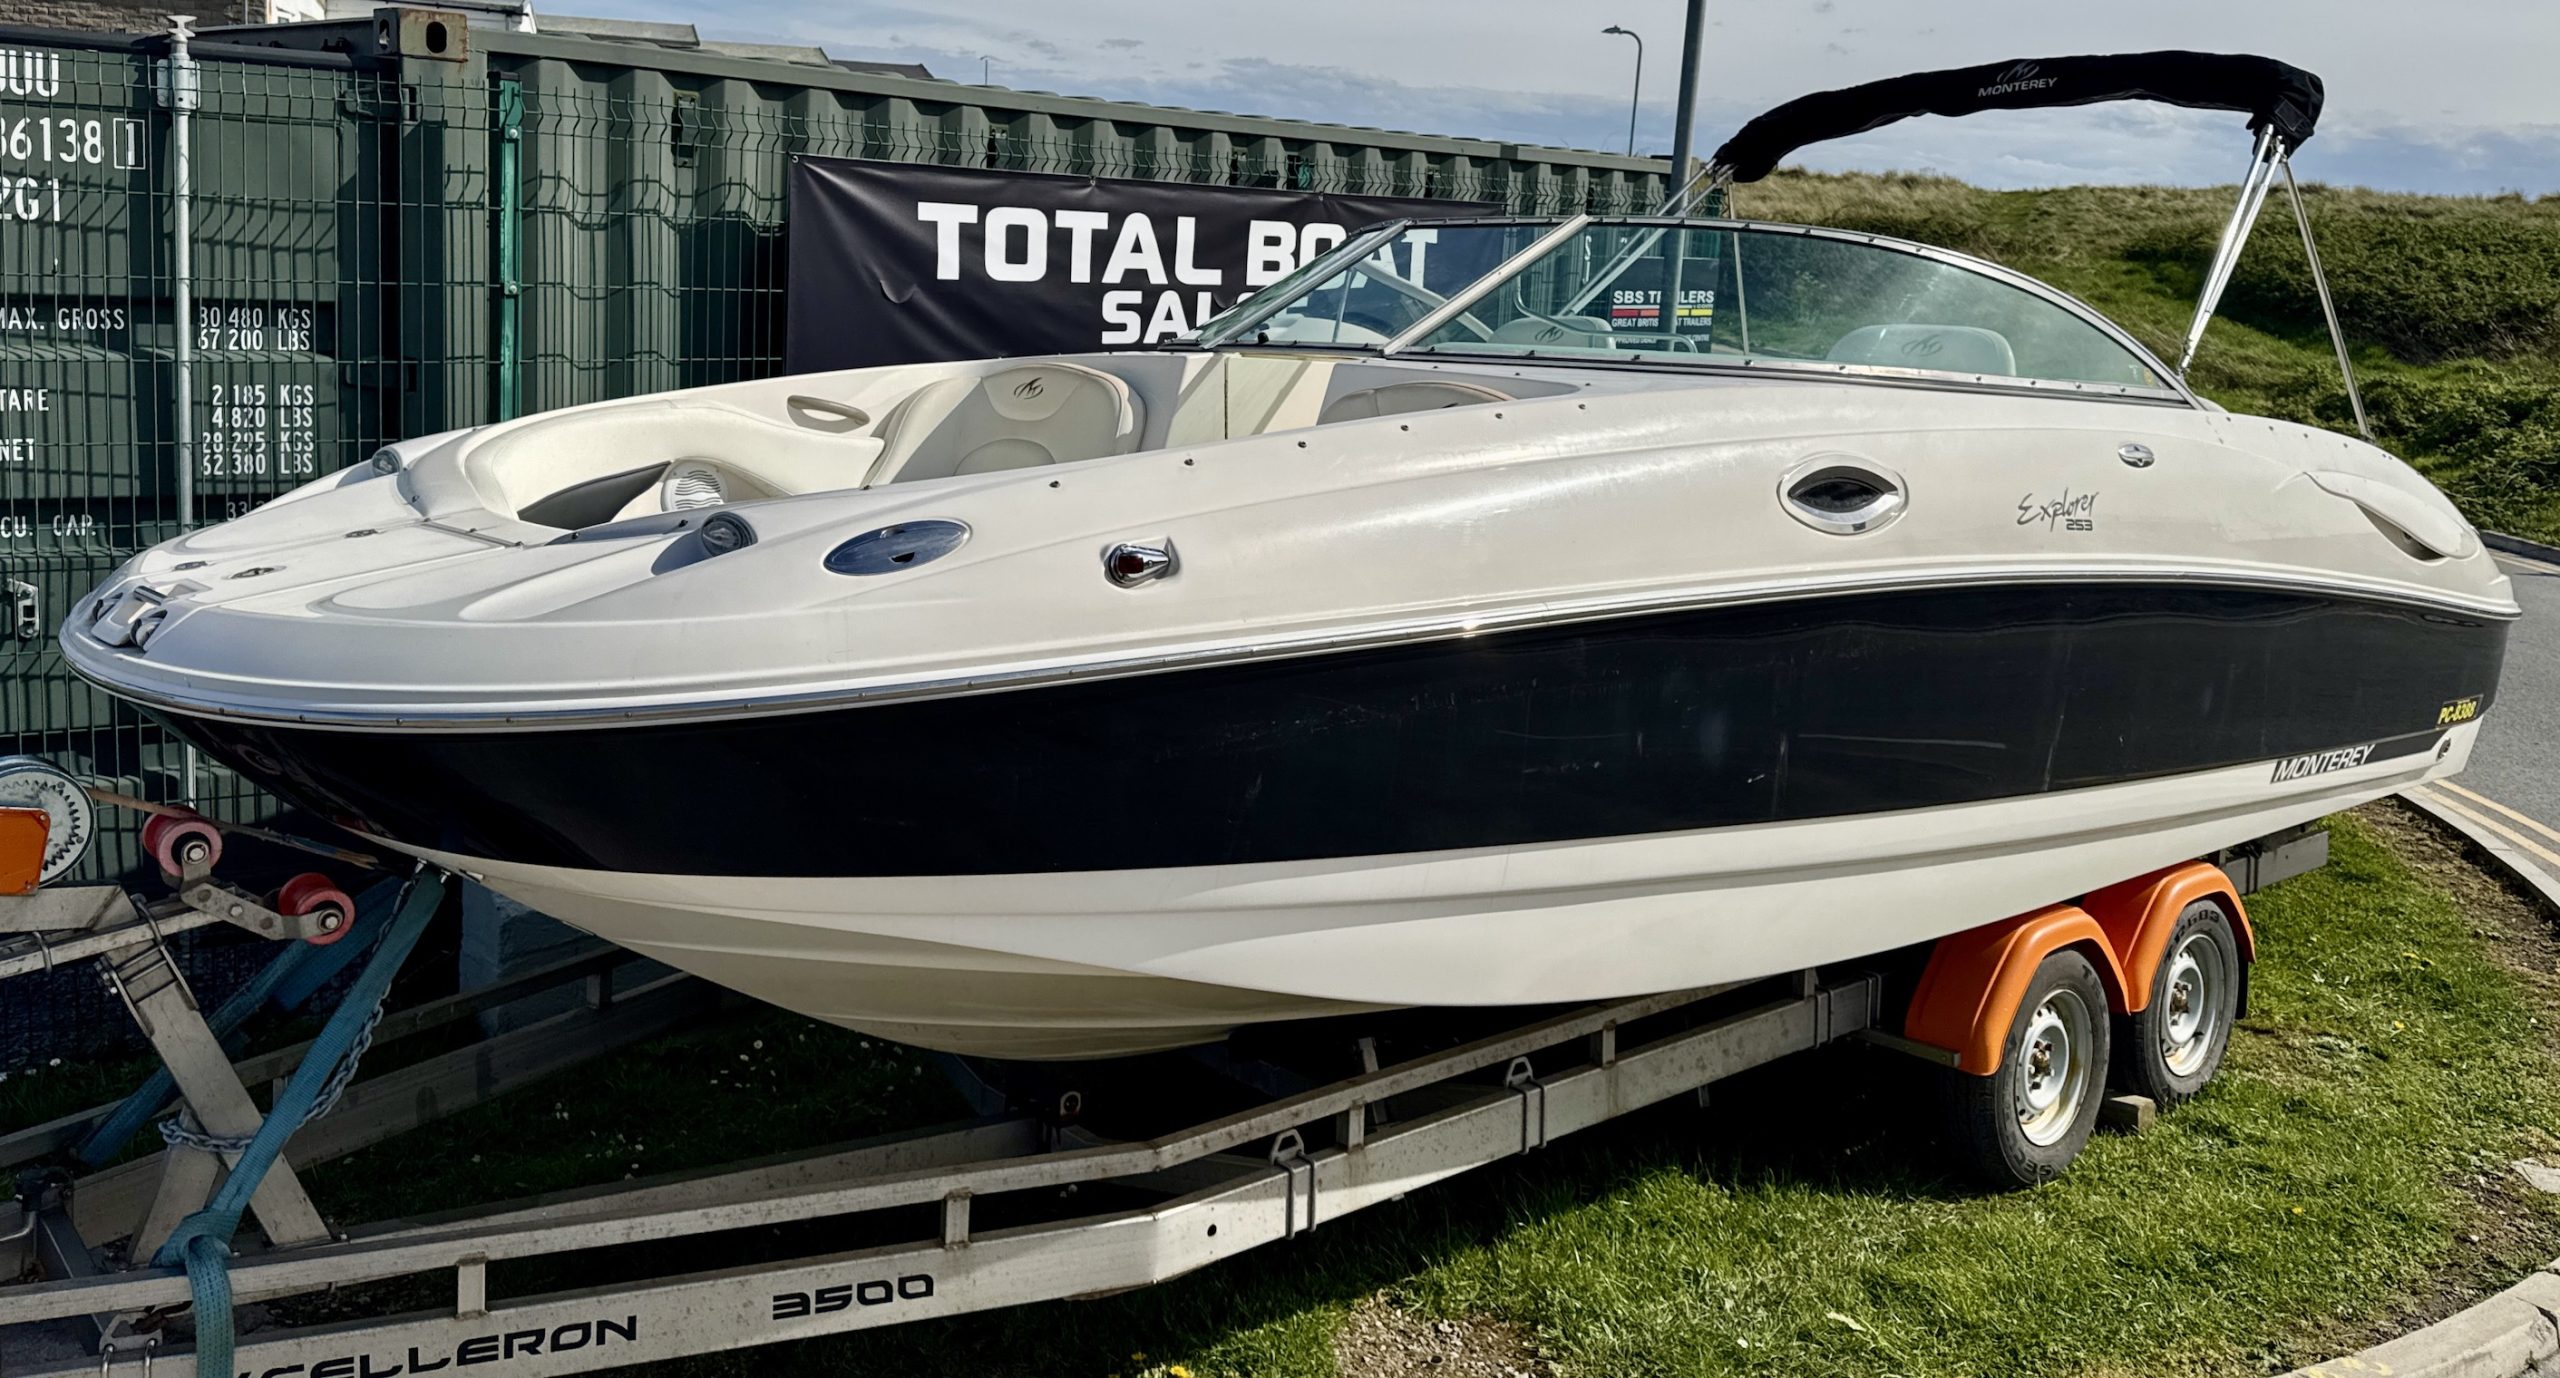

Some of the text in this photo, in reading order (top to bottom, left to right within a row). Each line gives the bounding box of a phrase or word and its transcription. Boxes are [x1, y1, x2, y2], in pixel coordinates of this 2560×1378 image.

[0, 49, 60, 98] UU
[1978, 77, 2058, 97] MONTEREY
[0, 116, 105, 164] 6138
[917, 201, 1223, 286] TOTAL
[1613, 290, 1714, 304] SBS TLERS
[58, 307, 125, 330] GROSS
[278, 307, 311, 329] KGS
[1611, 318, 1636, 327] GREAT
[1637, 318, 1659, 327] BRITIS
[1683, 317, 1712, 326] TRAILERS
[277, 330, 310, 351] LBS
[280, 384, 314, 406] KGS
[280, 406, 313, 428] LBS
[0, 438, 35, 462] NET
[280, 431, 314, 453] KGS
[280, 453, 313, 474] LBS
[2017, 487, 2100, 533] Explorer
[1, 514, 97, 538] CU. CAP.
[2065, 518, 2093, 531] 253
[2273, 743, 2377, 783] MONTEREY
[772, 1273, 934, 1321] 3500
